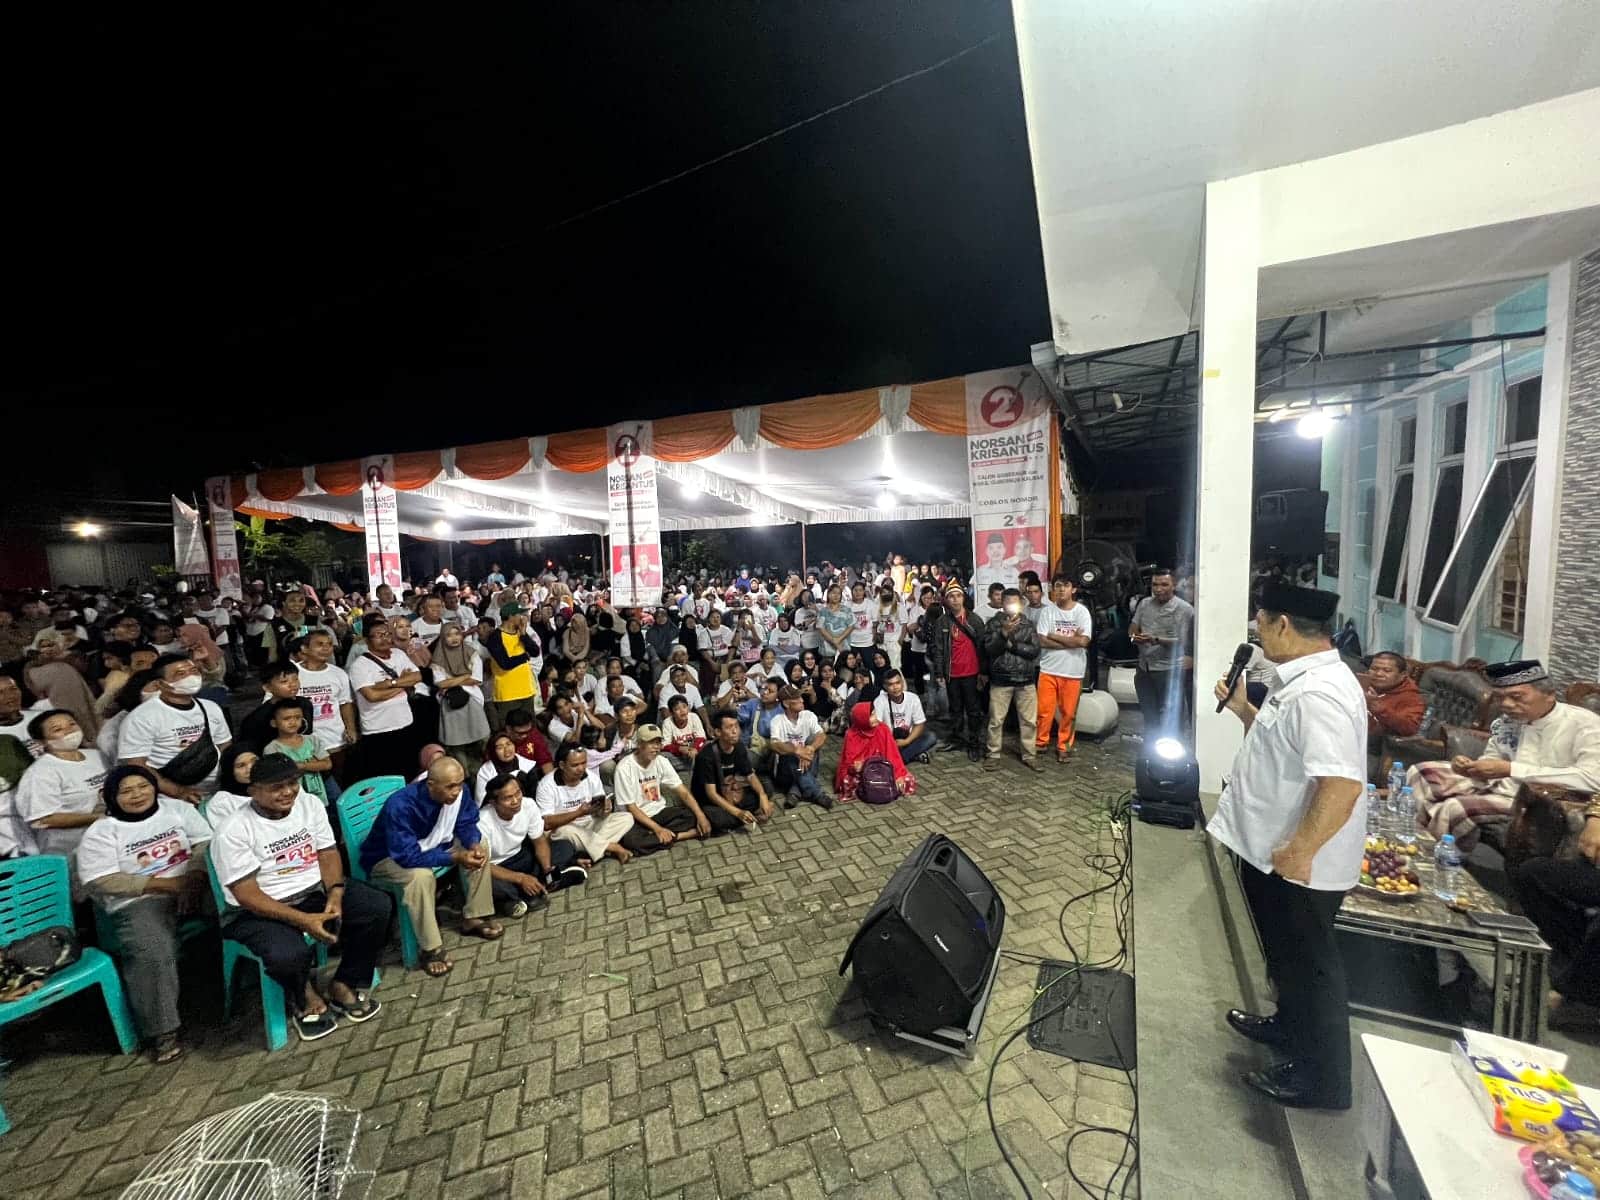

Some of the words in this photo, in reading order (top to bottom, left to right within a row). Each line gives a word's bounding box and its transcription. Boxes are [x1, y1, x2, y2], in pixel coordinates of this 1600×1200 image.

[989, 388, 1016, 423] 2
[970, 434, 1025, 450] NORSAN
[970, 442, 1044, 460] KRISANTUS
[609, 472, 642, 483] NORAN
[610, 479, 655, 491] KRISNTUS
[1003, 514, 1014, 527] 2
